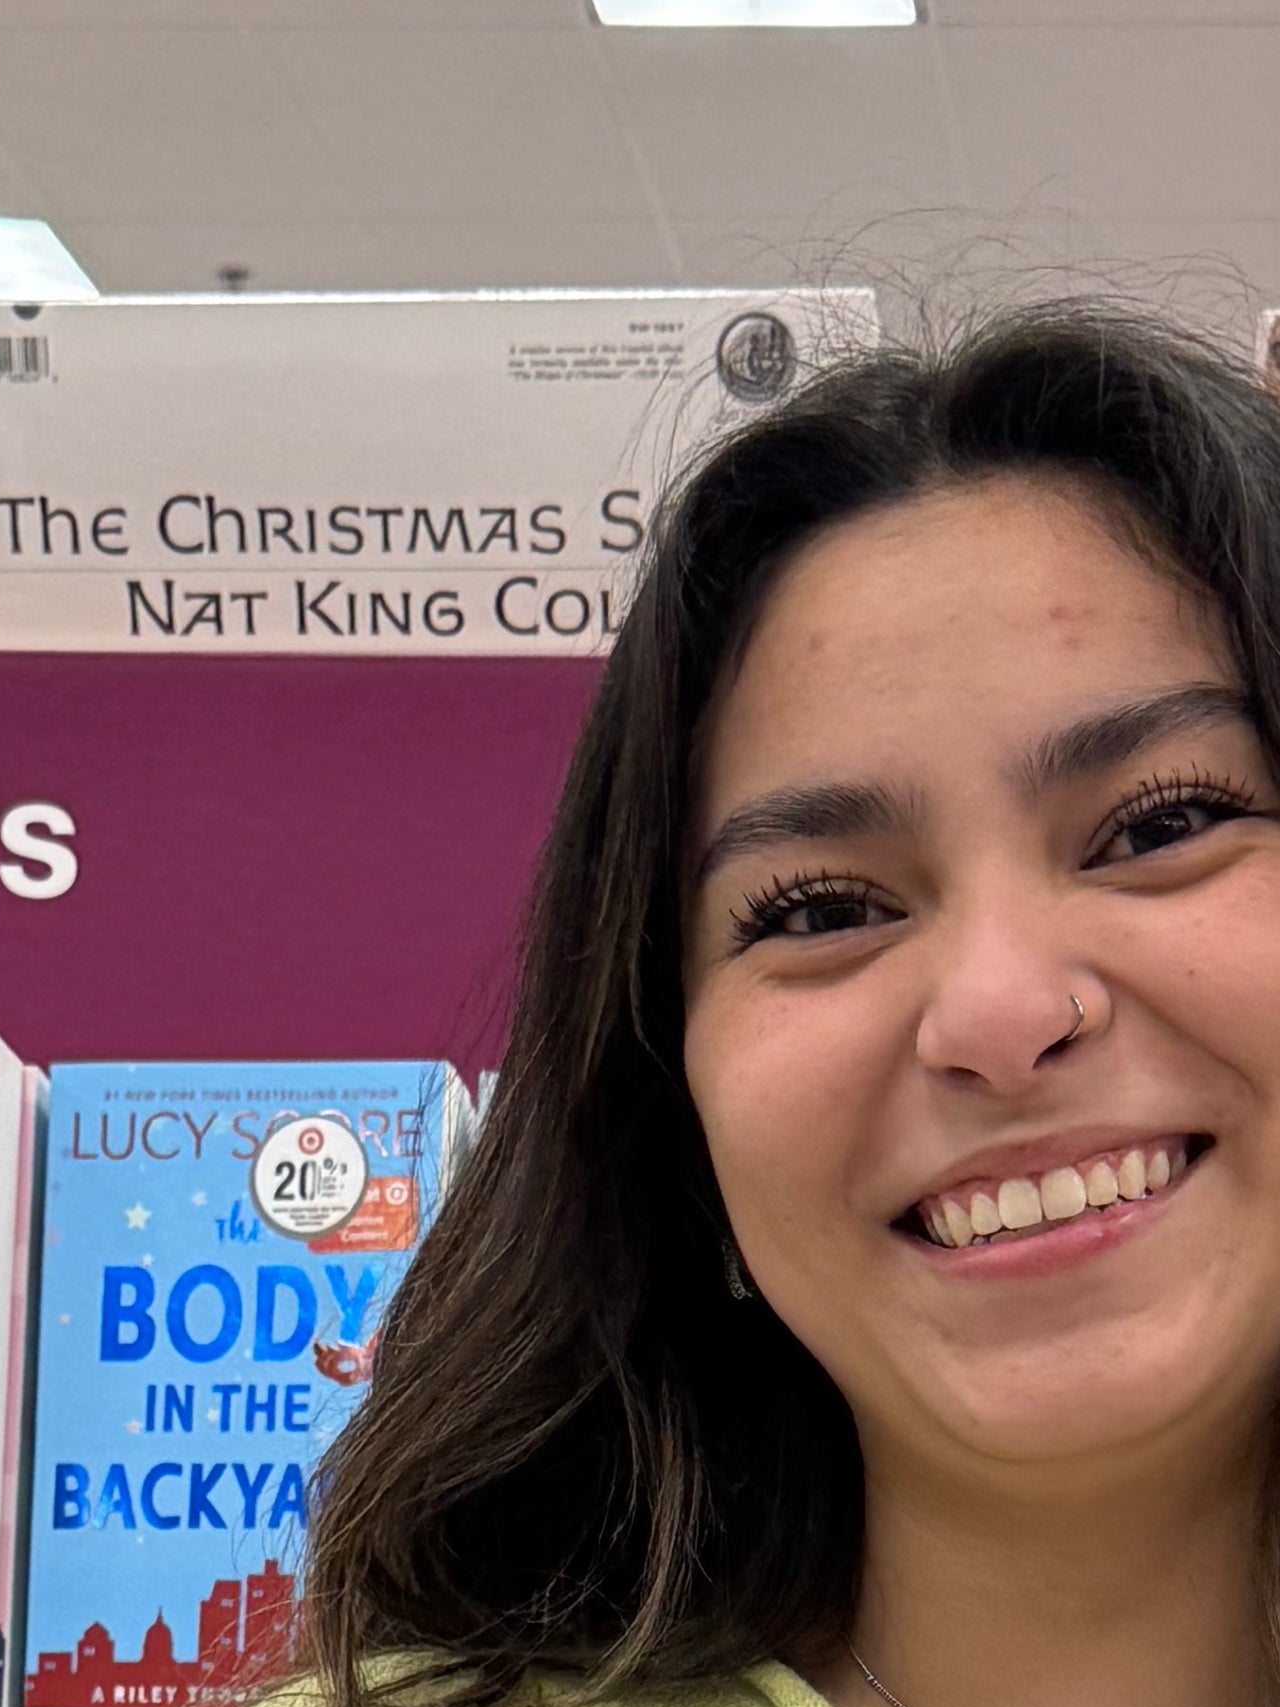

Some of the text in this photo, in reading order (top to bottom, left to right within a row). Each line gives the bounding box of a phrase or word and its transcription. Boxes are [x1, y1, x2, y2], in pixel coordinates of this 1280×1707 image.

[73, 1112, 219, 1160] LUCY
[100, 1264, 383, 1363] BODY
[145, 1384, 311, 1433] IN THE
[114, 1687, 177, 1704] RILEY
